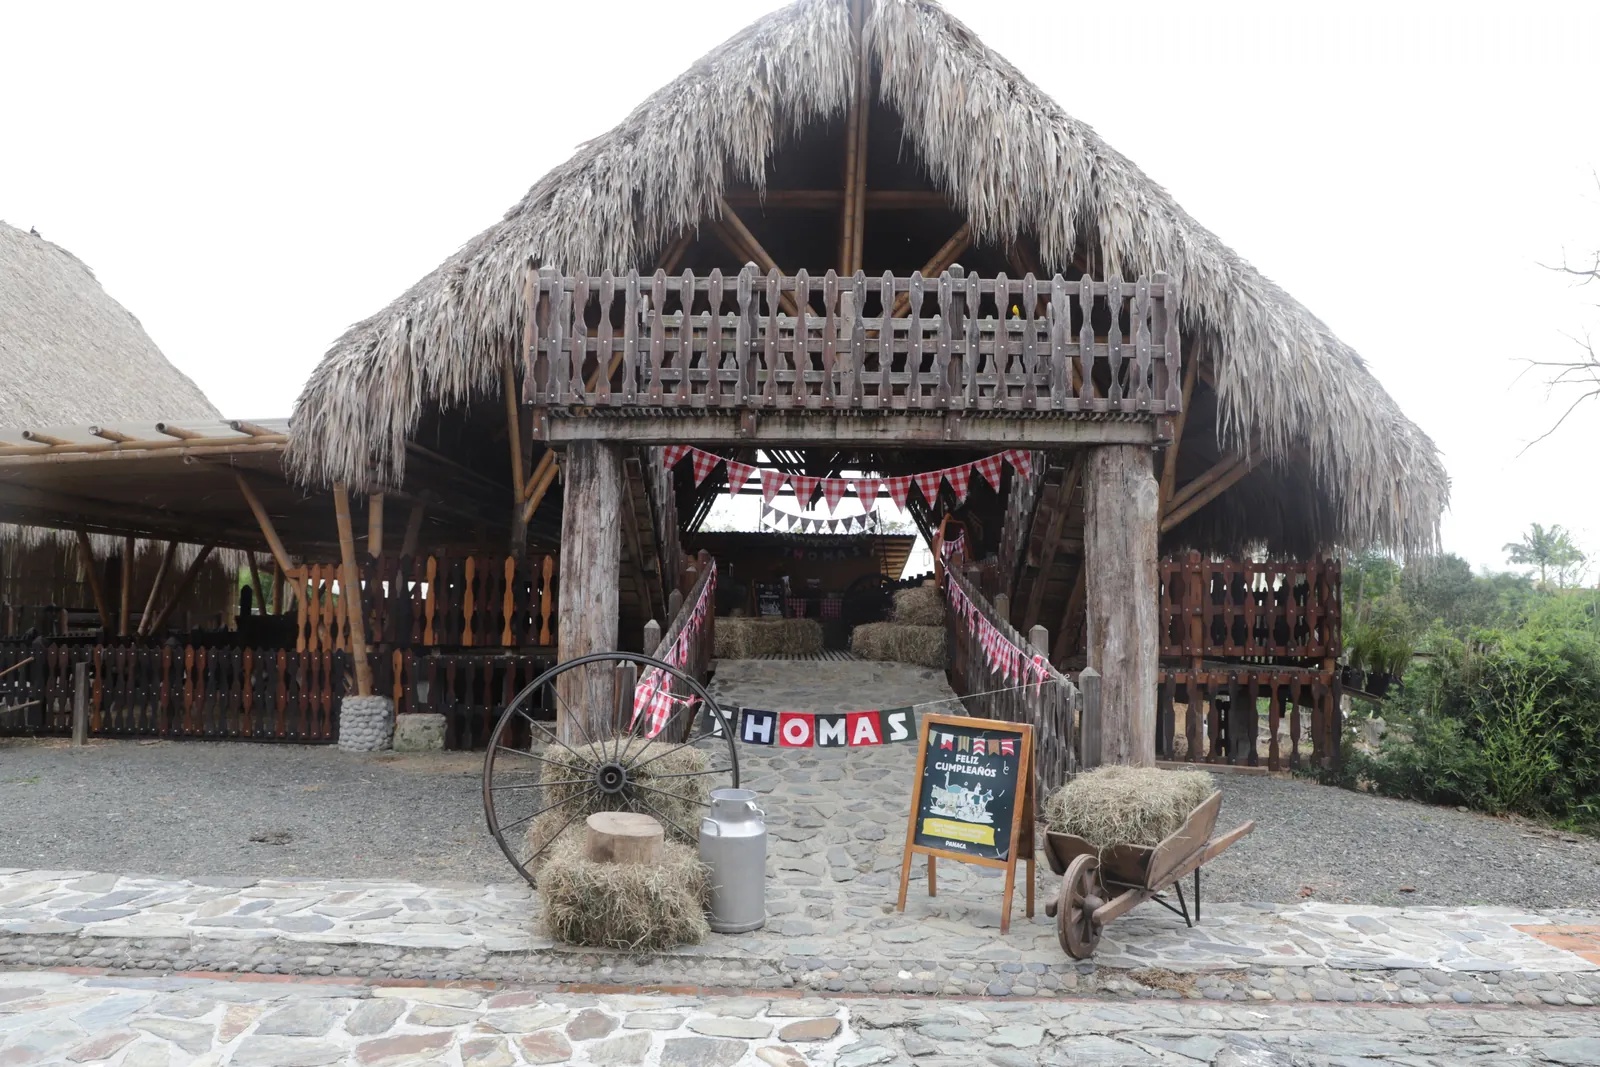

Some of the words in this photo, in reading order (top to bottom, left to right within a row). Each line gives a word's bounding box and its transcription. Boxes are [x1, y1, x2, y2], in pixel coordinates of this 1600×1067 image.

[709, 709, 908, 746] THOMAS
[955, 753, 979, 765] FELIZ
[935, 761, 997, 778] CUMPLEAÑOS
[945, 840, 967, 850] PANACA
